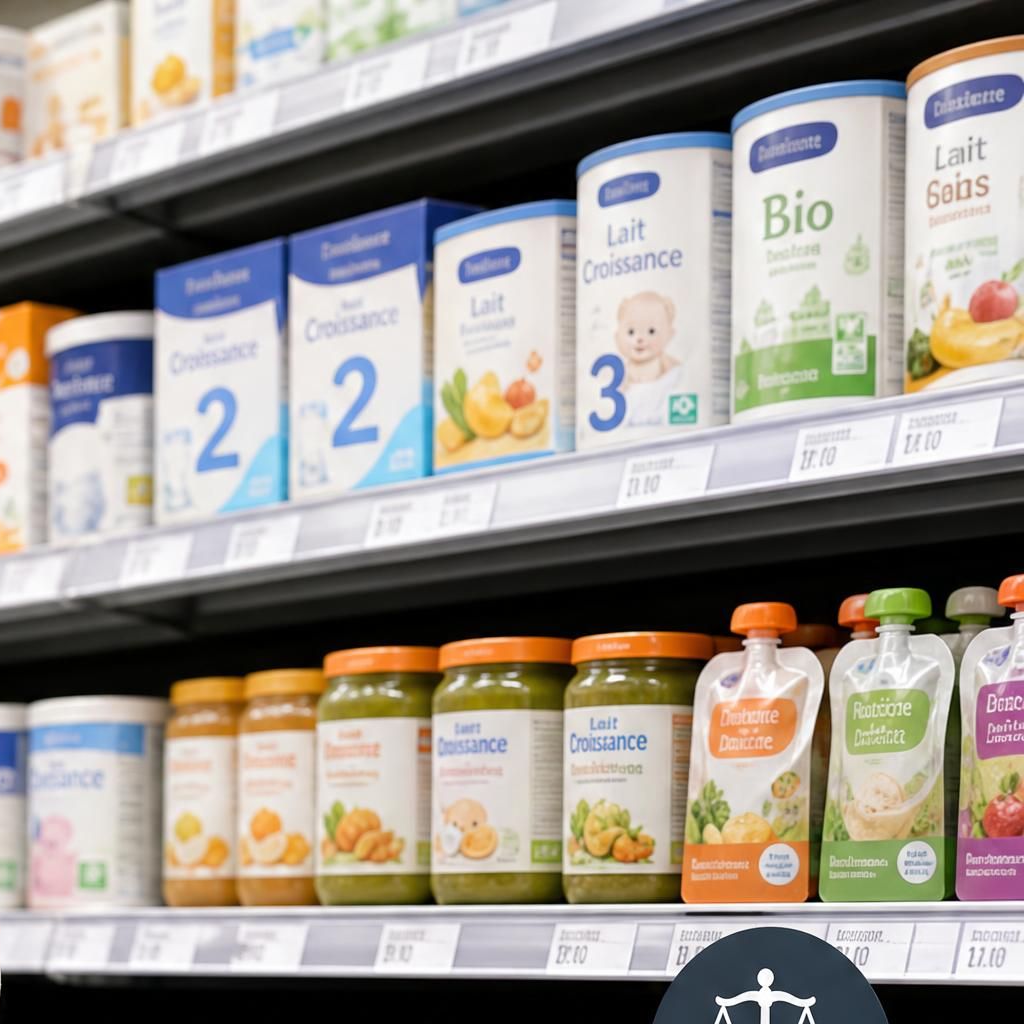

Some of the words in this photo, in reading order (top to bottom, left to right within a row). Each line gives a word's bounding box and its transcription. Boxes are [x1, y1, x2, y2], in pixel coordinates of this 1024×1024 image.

[935, 136, 988, 171] Lait
[607, 218, 646, 248] Lait
[763, 189, 834, 241] Bio
[583, 247, 683, 284] Croissance
[332, 355, 380, 449] 2
[589, 353, 627, 432] 3
[195, 386, 240, 475] 2
